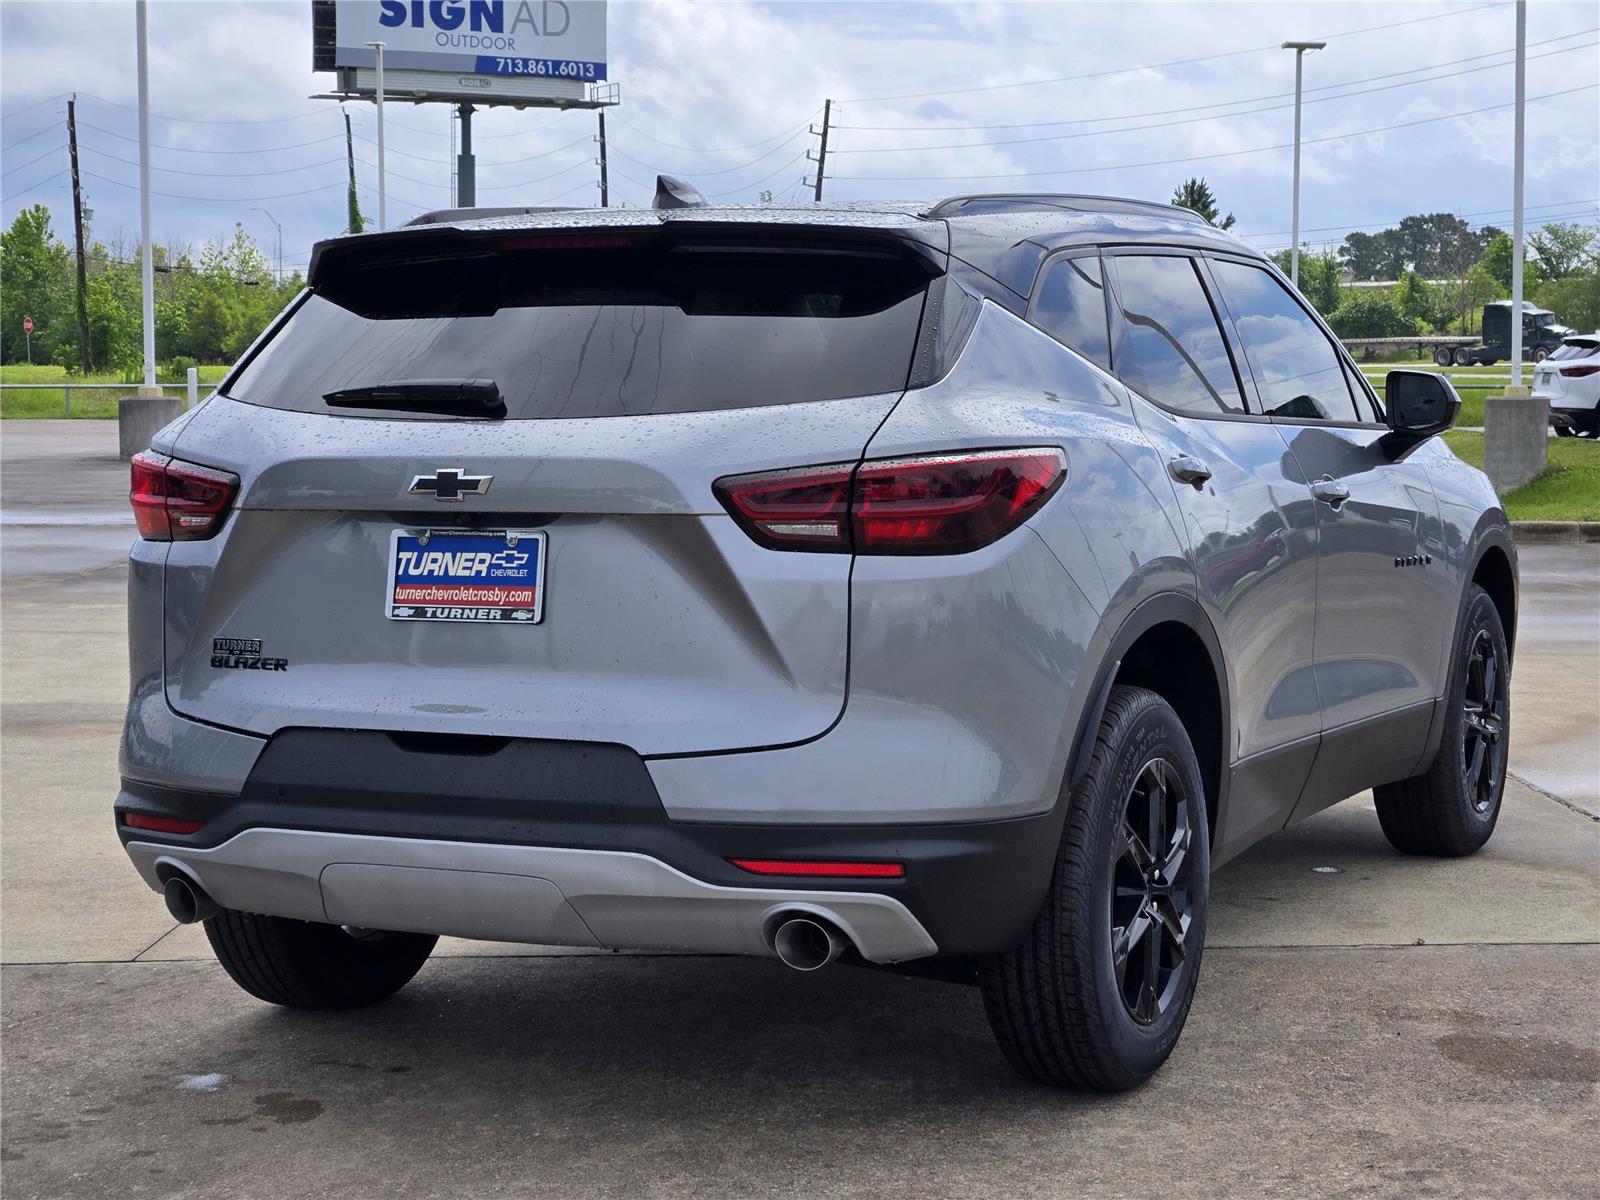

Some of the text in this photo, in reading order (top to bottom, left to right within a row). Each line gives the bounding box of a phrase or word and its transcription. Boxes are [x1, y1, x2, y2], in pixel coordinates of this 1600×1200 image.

[435, 32, 516, 51] OUTDOOR
[496, 58, 595, 77] 713.861.6013
[397, 551, 492, 577] TURNER
[490, 568, 529, 577] CHEVROLET
[395, 586, 532, 604] turnerchevroletcrosby.com
[424, 607, 503, 620] TURNER
[215, 639, 260, 651] TURNER
[211, 656, 288, 671] BLAZER
